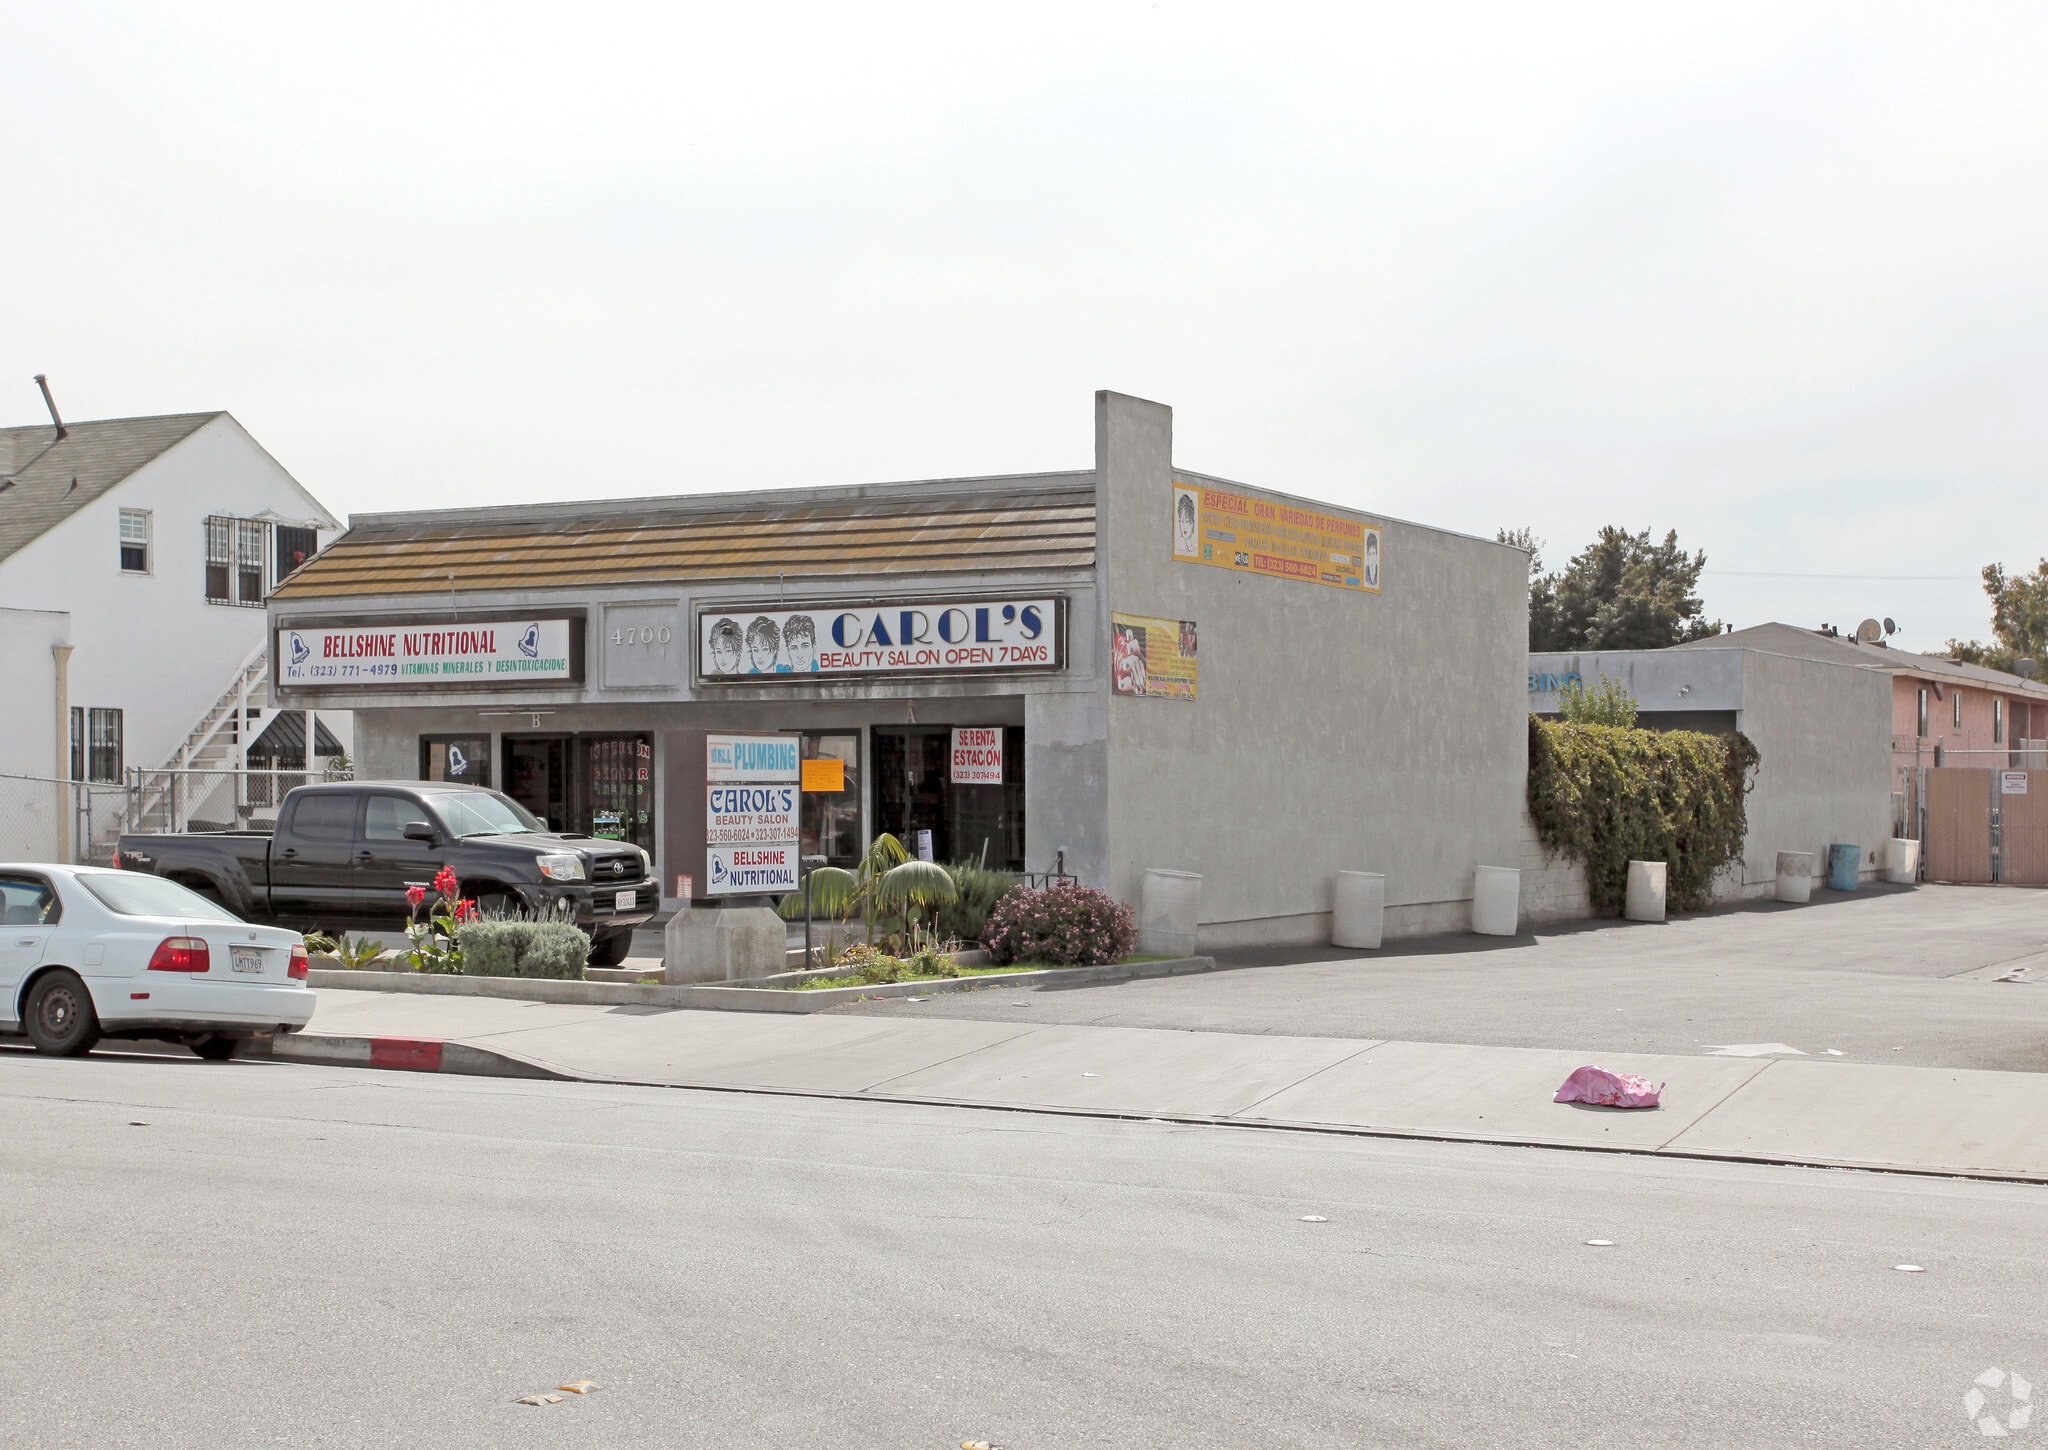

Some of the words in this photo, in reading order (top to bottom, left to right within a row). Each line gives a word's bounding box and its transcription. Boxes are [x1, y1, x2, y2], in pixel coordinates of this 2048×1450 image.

[1204, 492, 1249, 513] ESPECIAL
[1254, 503, 1275, 520] GRAN
[1280, 508, 1313, 528] VARIEDAD
[1316, 517, 1325, 531] DE
[1327, 519, 1361, 538] PERFUMES
[1268, 558, 1284, 573] (323)
[1285, 562, 1317, 577] 560-6024
[611, 626, 671, 645] 4700
[832, 604, 1042, 649] CAROL'S
[323, 634, 396, 658] BELLSHINE
[403, 630, 496, 656] NUTRITIONAL
[820, 651, 884, 668] BEAUTY
[887, 648, 941, 666] SALON
[945, 646, 993, 664] OPEN
[999, 646, 1008, 662] 7
[1011, 645, 1048, 662] DAYS
[287, 666, 305, 678] Tel.
[310, 665, 337, 677] (323)
[342, 664, 398, 676] 771-4979
[401, 662, 439, 675] VITAMINAS
[442, 661, 484, 674] MINERALES
[487, 661, 492, 673] Y
[495, 658, 566, 672] DESINTOXICACIONE
[532, 713, 541, 728] B
[959, 730, 969, 746] SE
[970, 730, 996, 747] RENTA
[735, 743, 796, 770] PLUMBING
[953, 770, 970, 781] (323)
[710, 789, 792, 813] CAROL'S
[716, 815, 753, 826] BEAUTY
[758, 814, 789, 824] SALON
[733, 851, 785, 866] BELLSHINE
[730, 869, 794, 887] NUTRITIONAL
